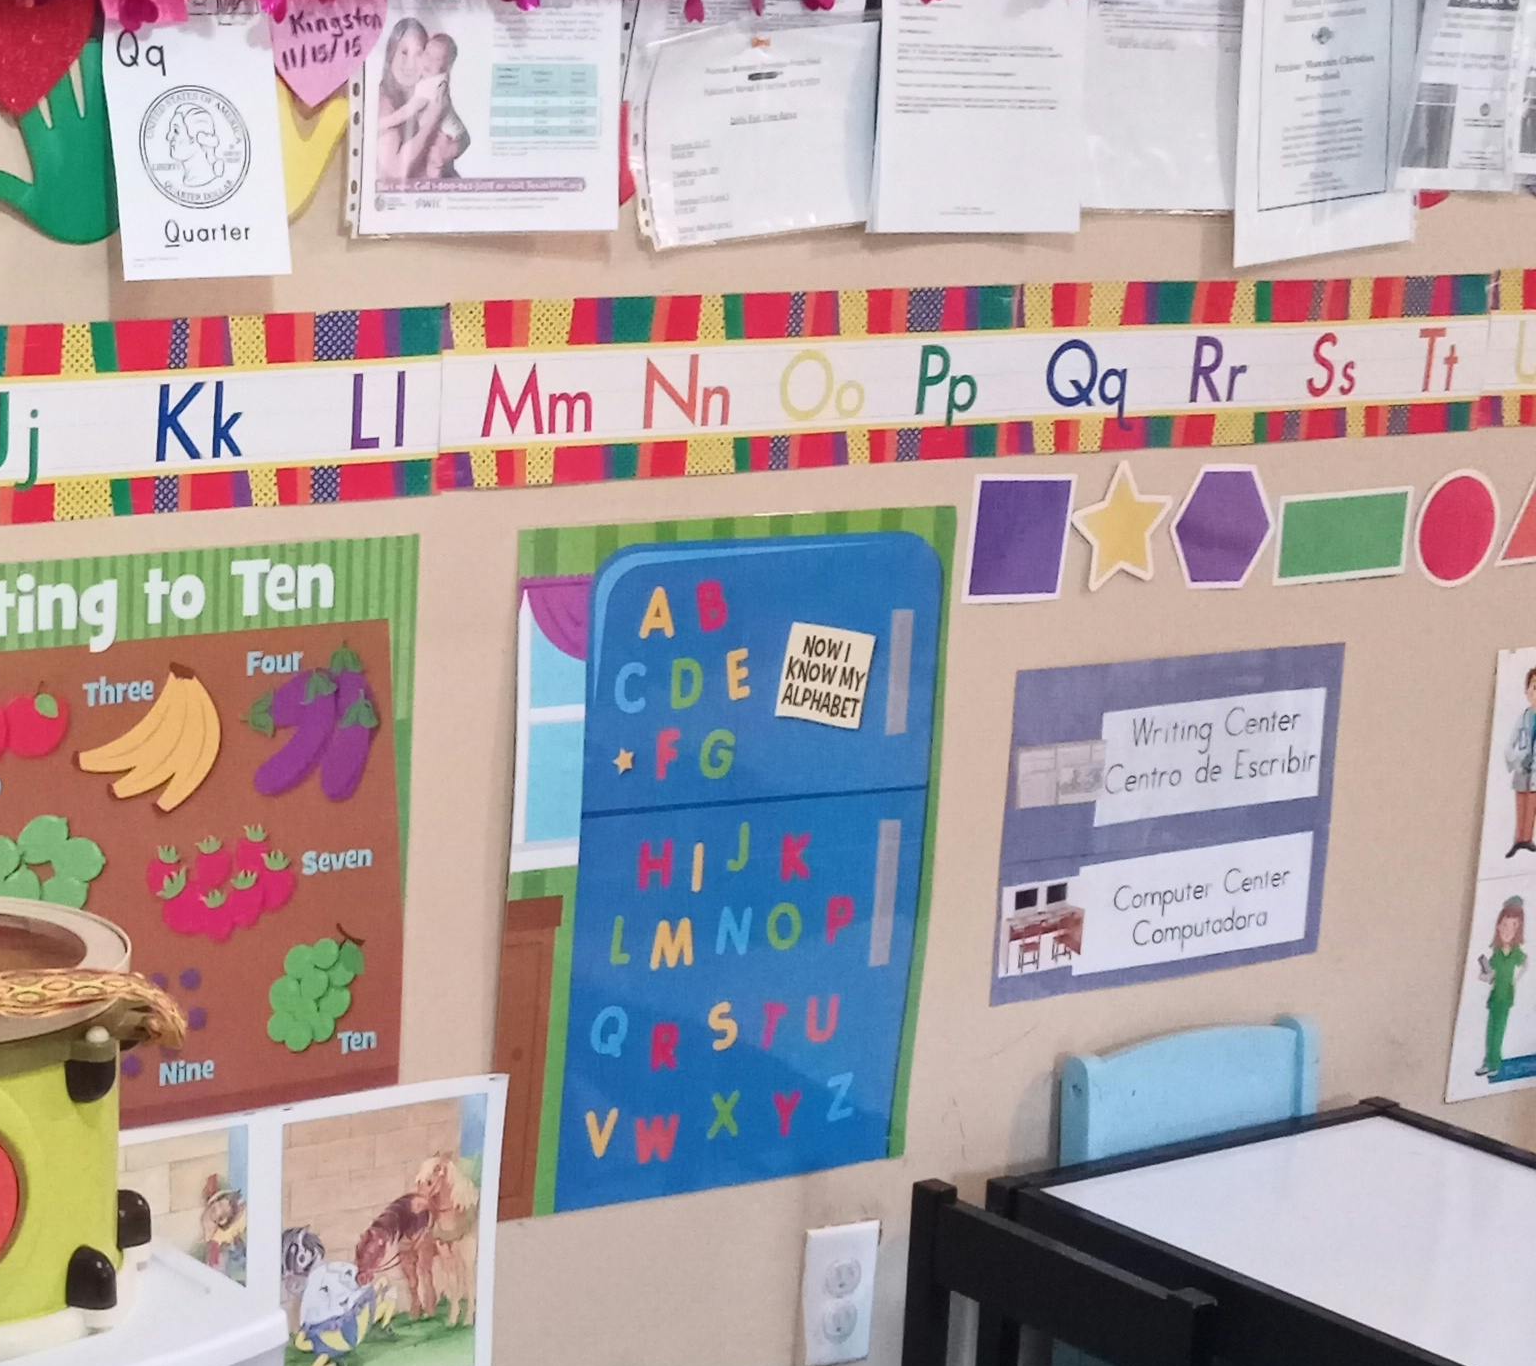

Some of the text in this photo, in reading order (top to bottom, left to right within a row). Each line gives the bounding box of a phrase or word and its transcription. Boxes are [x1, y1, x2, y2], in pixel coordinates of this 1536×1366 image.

[289, 5, 384, 38] Kingston
[116, 30, 166, 76] Qq
[281, 36, 364, 72] 11/15/15
[164, 219, 251, 244] Quarter
[155, 381, 244, 463] Kk
[350, 370, 407, 450] Ll
[480, 362, 593, 438] Mm
[643, 353, 731, 430] Nn
[779, 348, 865, 422] Oo
[914, 344, 979, 428] Pp
[1046, 338, 1132, 431] Qq
[1189, 335, 1249, 403] Rr
[1306, 332, 1357, 398] Ss
[1419, 327, 1460, 392] Tt
[142, 566, 207, 622] to
[230, 558, 336, 618] Ten
[639, 580, 728, 640] A B
[246, 649, 304, 678] Four
[803, 634, 851, 664] NOW I
[82, 676, 155, 707] Three
[614, 647, 751, 715] C D E
[784, 660, 866, 693] KNOW MY
[780, 685, 862, 721] ALPHABET
[655, 727, 737, 780] F G
[1131, 706, 1302, 756] Writing Center
[1103, 747, 1318, 796] Centro de Escribir
[300, 847, 373, 876] Seven
[638, 821, 812, 893] H I J K
[1112, 866, 1291, 918] Computer Center
[610, 895, 856, 970] L M N O P
[1131, 907, 1269, 953] Computadora
[336, 1026, 379, 1055] Ten
[590, 993, 841, 1072] Q R S T U
[157, 1056, 216, 1087] Nine
[585, 1071, 855, 1165] V W X Y Z
